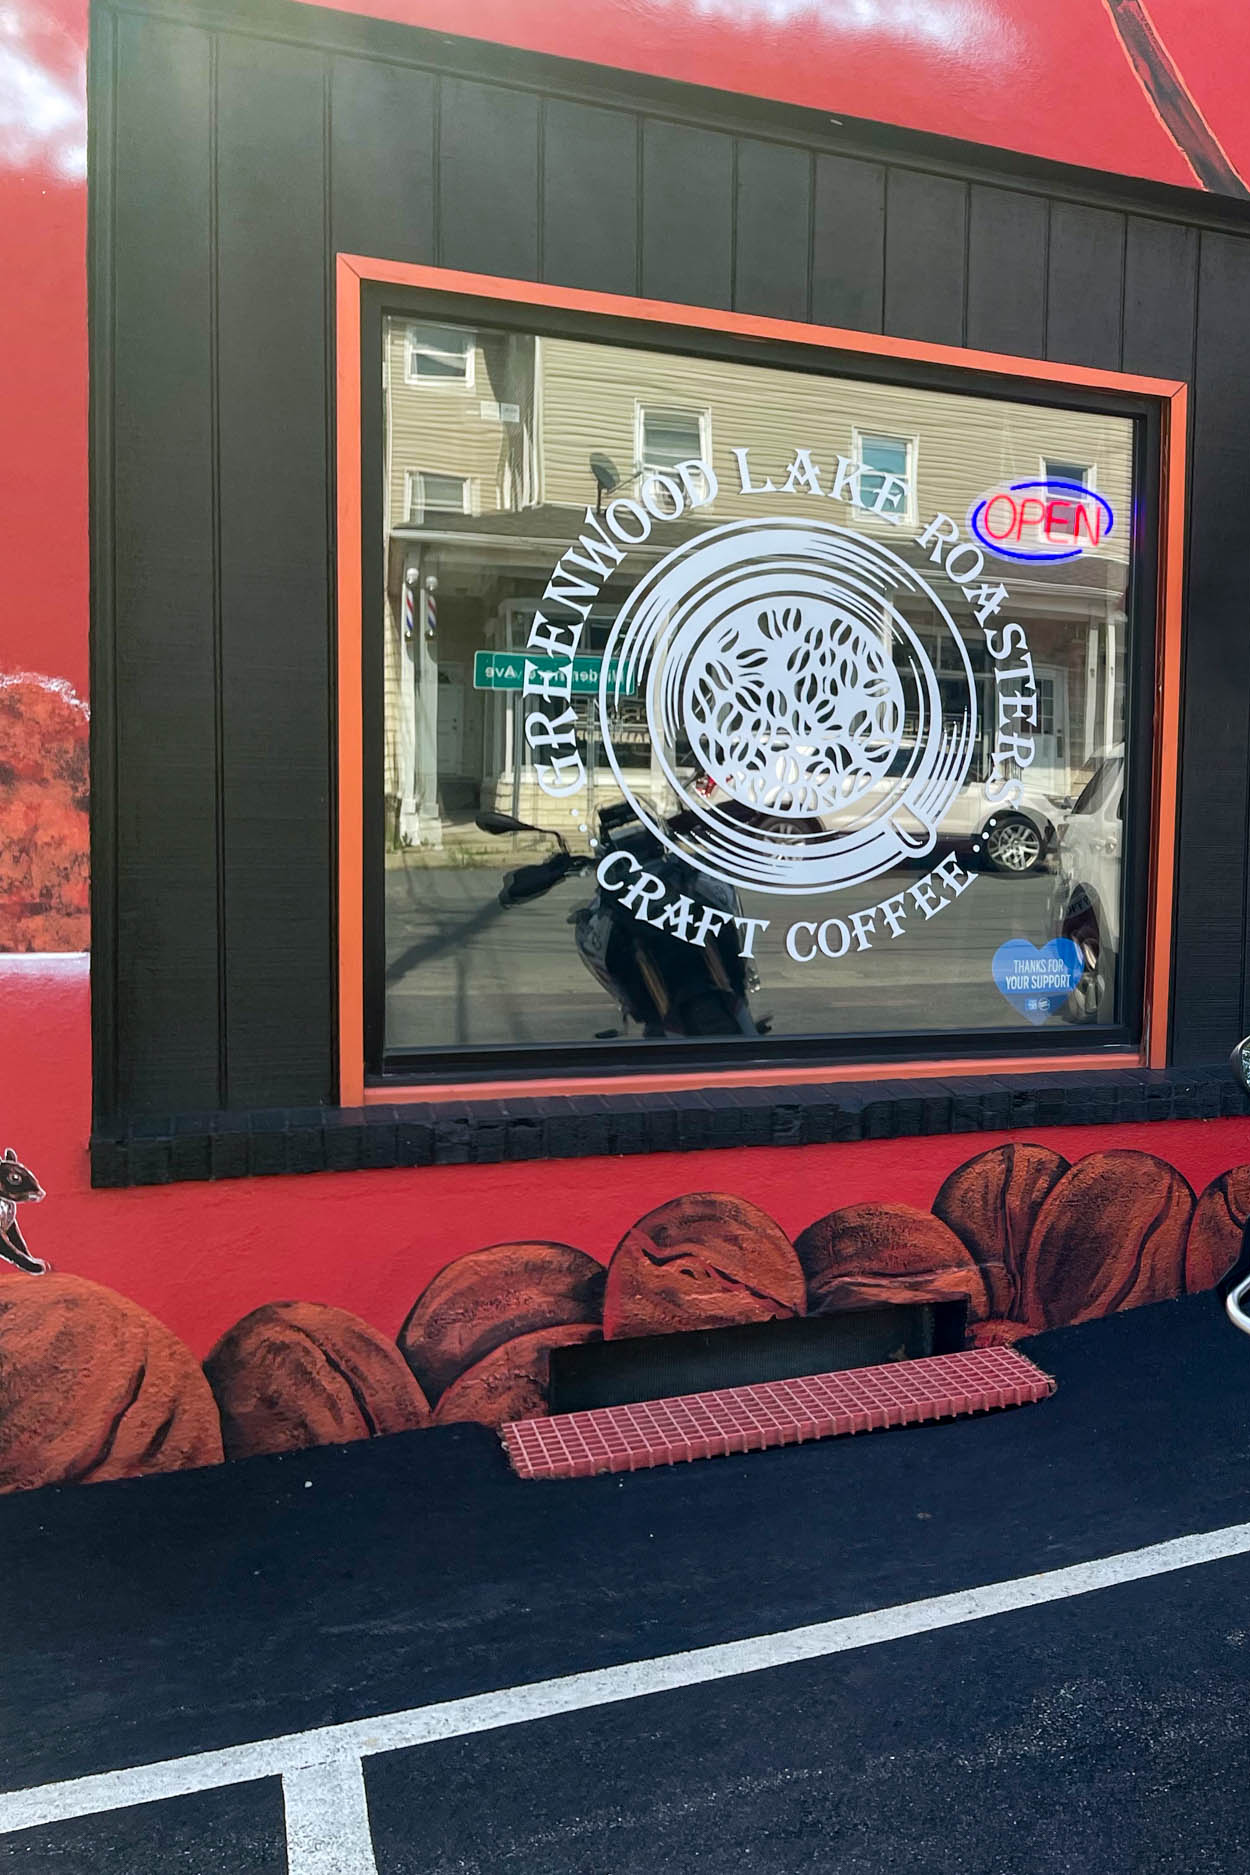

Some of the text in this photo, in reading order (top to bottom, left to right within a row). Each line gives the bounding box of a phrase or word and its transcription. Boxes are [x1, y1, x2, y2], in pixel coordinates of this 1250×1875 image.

[985, 493, 1101, 547] OPEN
[522, 447, 1038, 809] GREENWOOD LAKE ROASTERS
[596, 850, 979, 962] CRAFT COFFEE
[1005, 974, 1072, 990] YOUR SUPPORT
[1013, 958, 1064, 974] THANKS FOR
